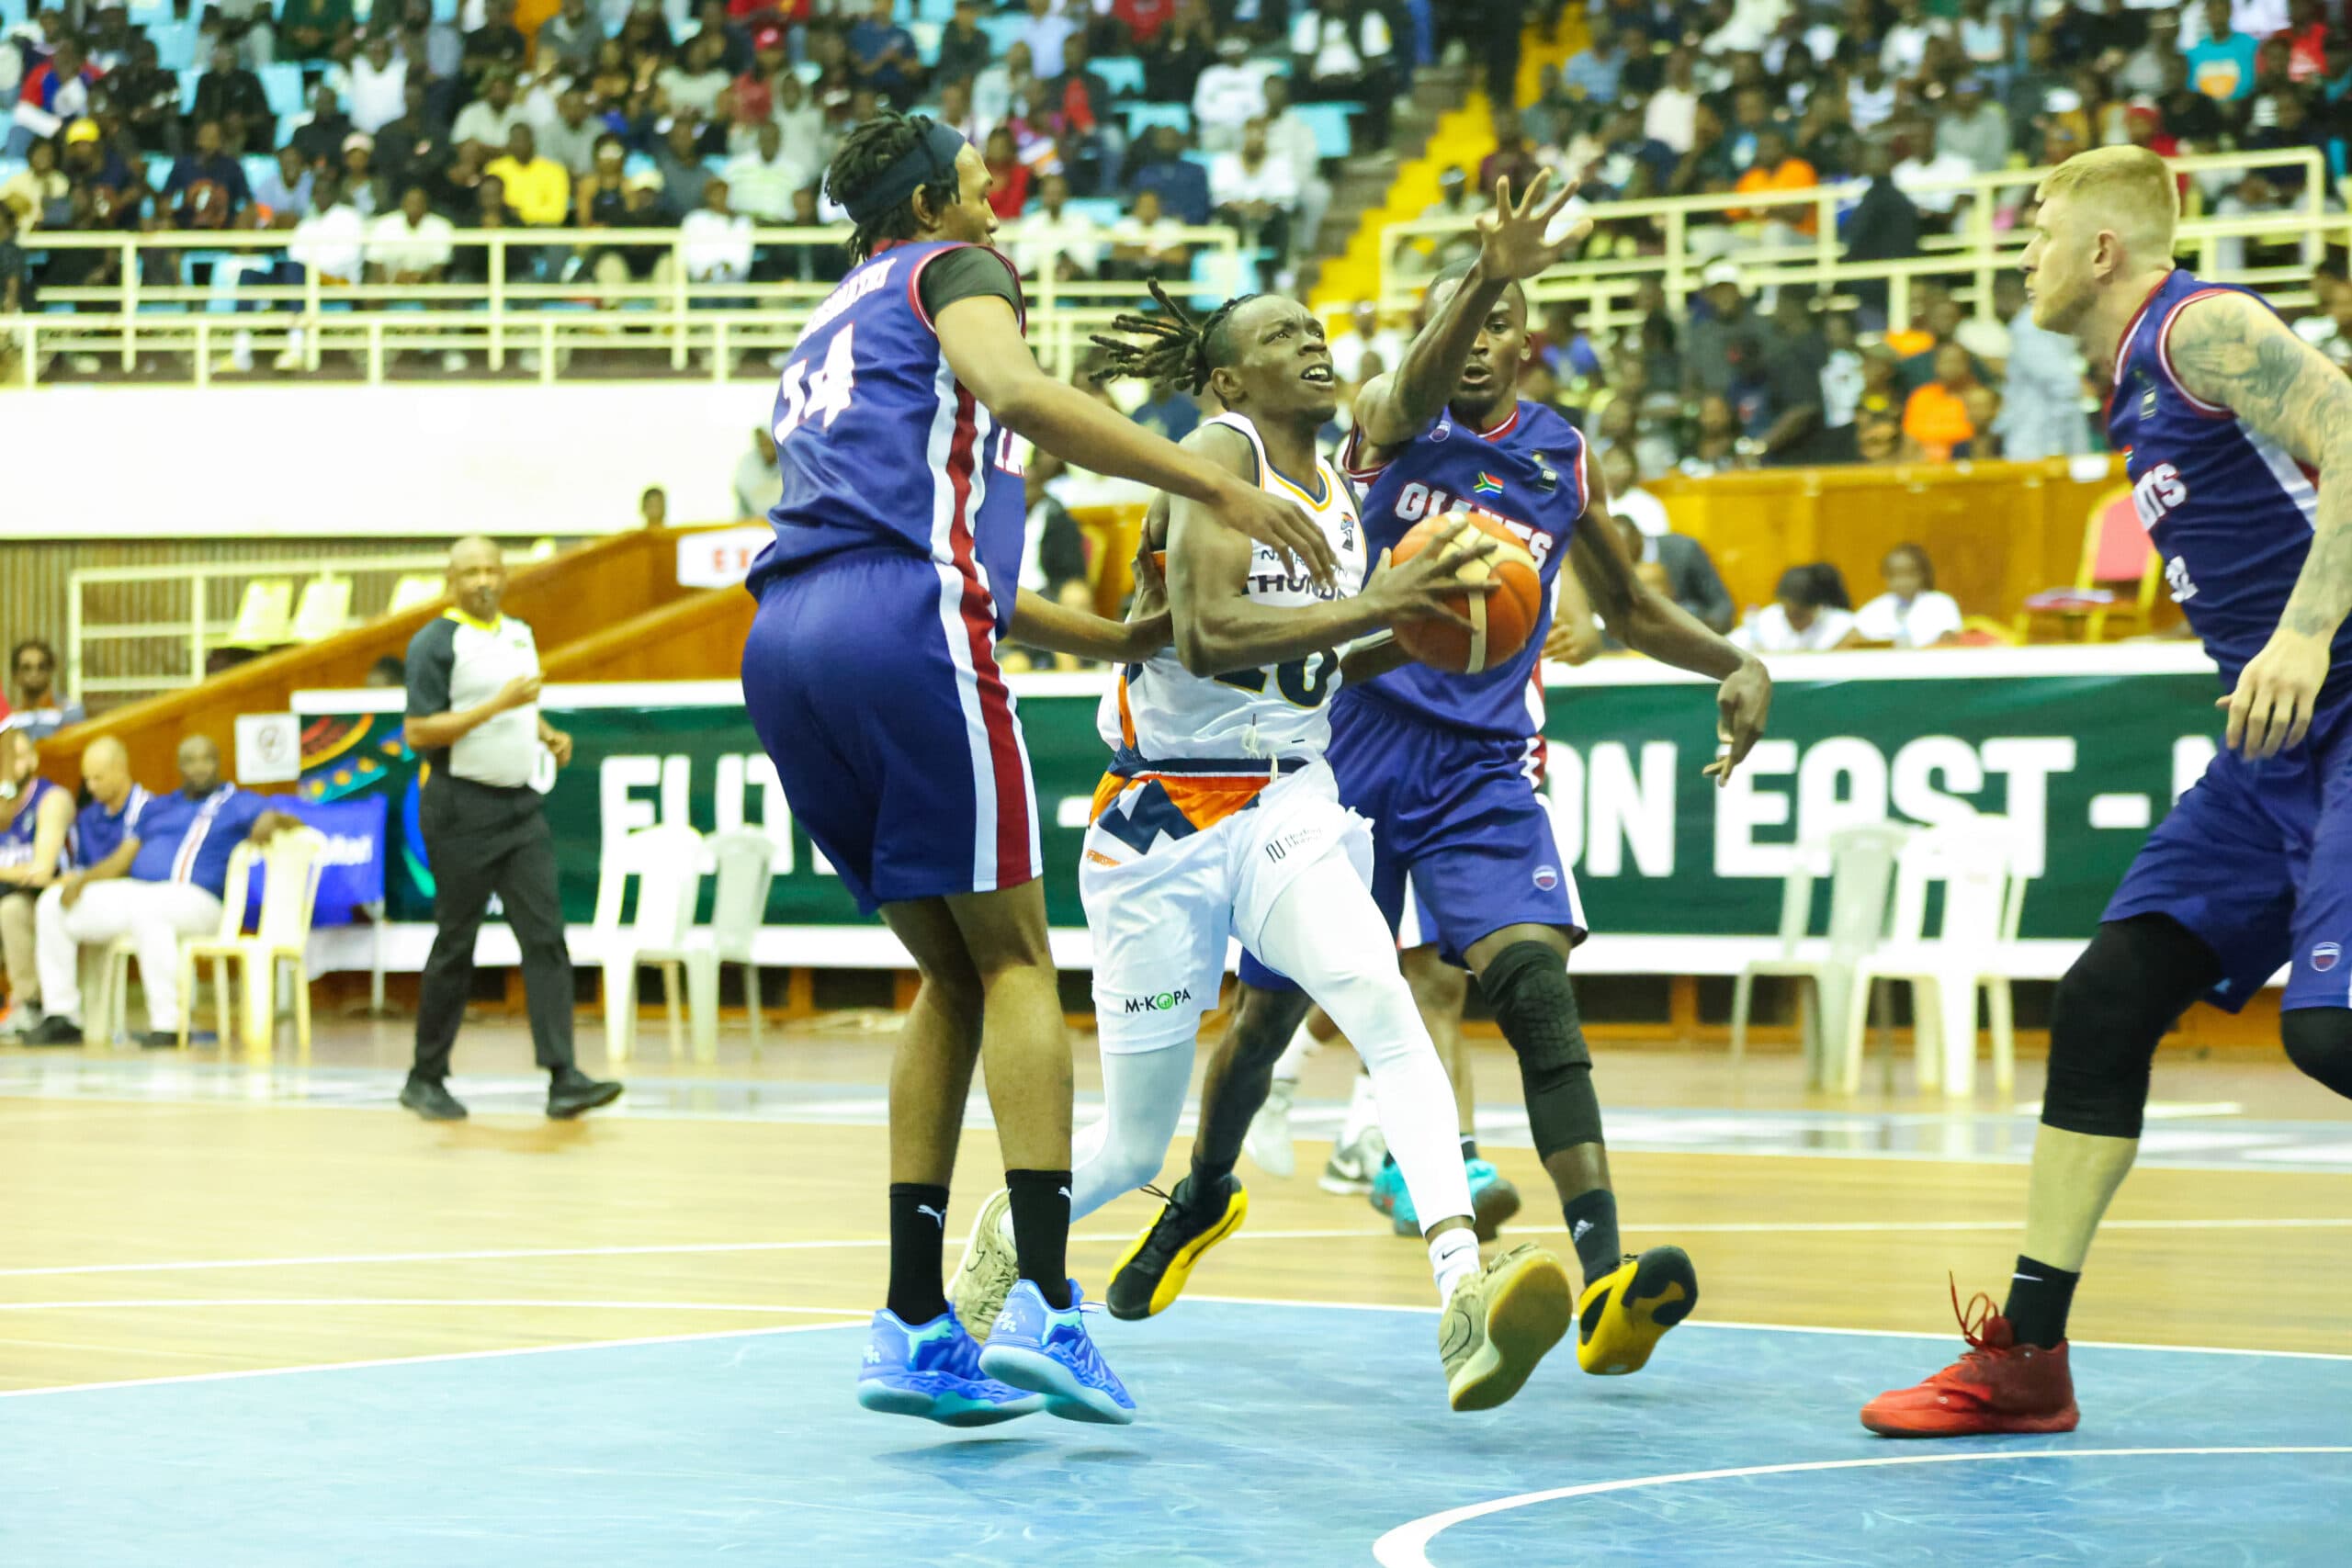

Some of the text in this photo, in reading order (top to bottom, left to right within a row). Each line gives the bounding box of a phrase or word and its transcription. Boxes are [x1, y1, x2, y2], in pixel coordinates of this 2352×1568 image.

[600, 753, 838, 875] ELIT
[1713, 736, 2076, 878] EAST
[1125, 987, 1192, 1013] M-KOPA
